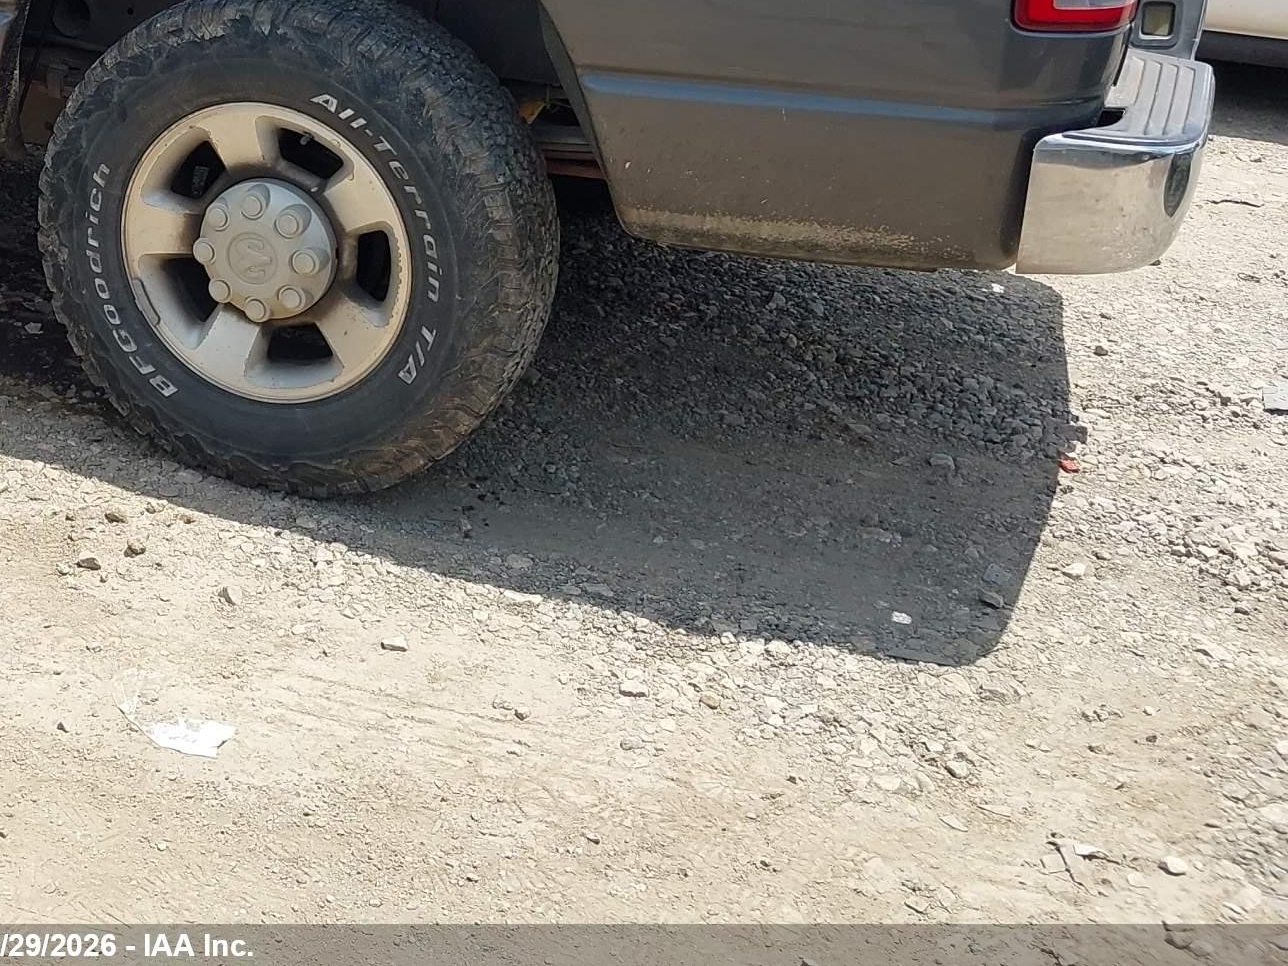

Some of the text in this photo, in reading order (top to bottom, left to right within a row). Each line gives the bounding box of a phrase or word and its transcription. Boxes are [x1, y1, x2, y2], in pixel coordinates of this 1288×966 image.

[85, 163, 179, 398] BFGoodrich
[310, 93, 443, 385] All-Terrain T/A
